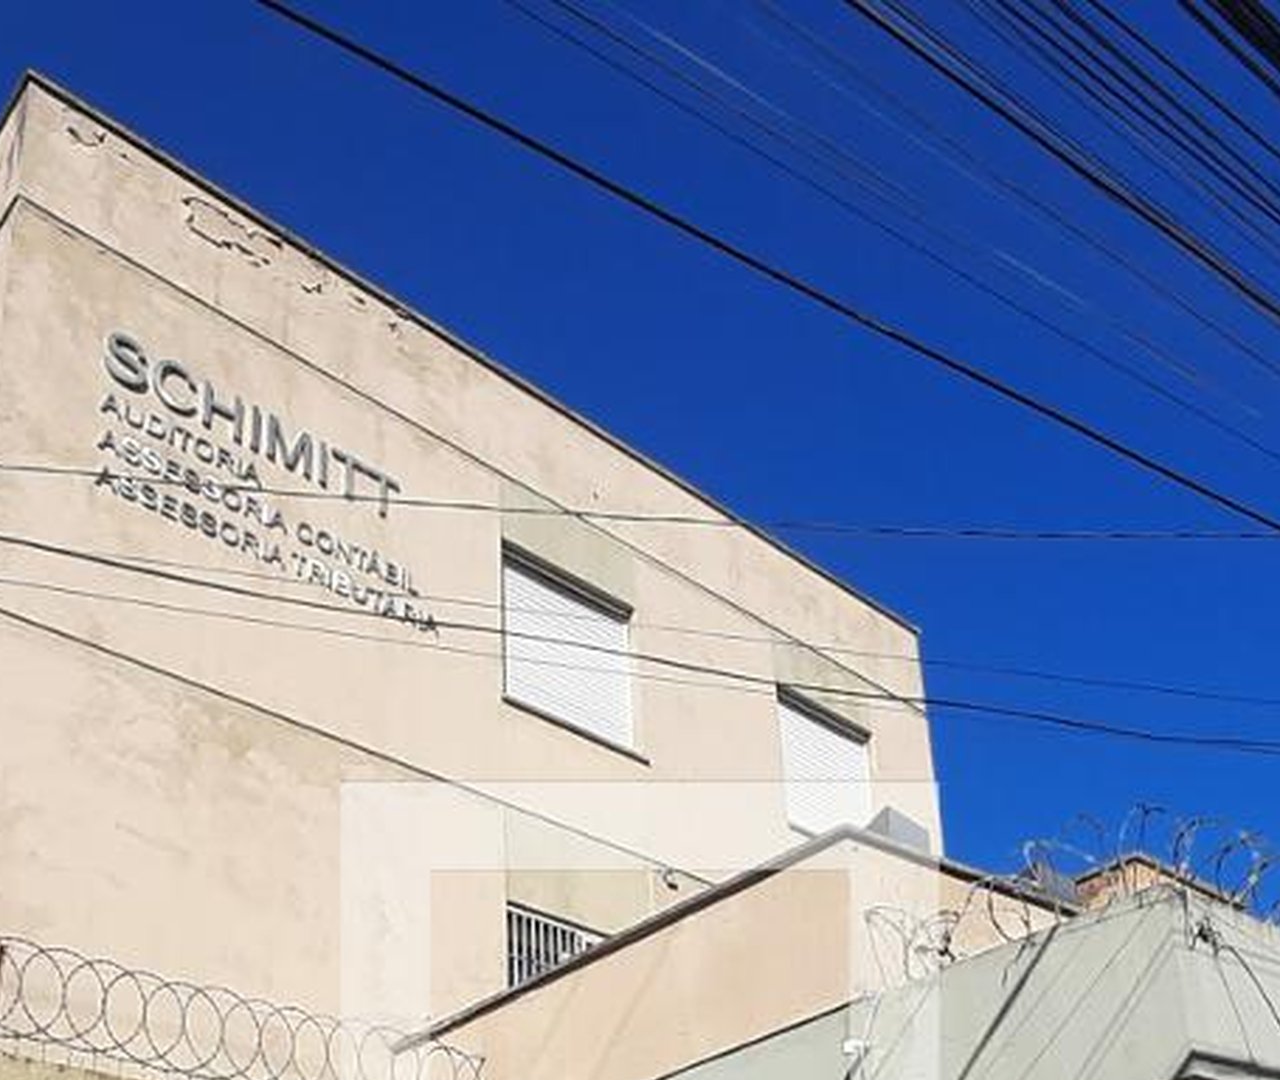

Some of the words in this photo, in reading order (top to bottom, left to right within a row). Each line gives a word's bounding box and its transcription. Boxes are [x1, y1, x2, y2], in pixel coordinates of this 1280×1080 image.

[100, 394, 262, 491] AUDITORIA
[104, 331, 401, 519] SCHIMITT
[94, 467, 285, 571] ASSESSORIA
[97, 430, 288, 535] ASSESSORIA
